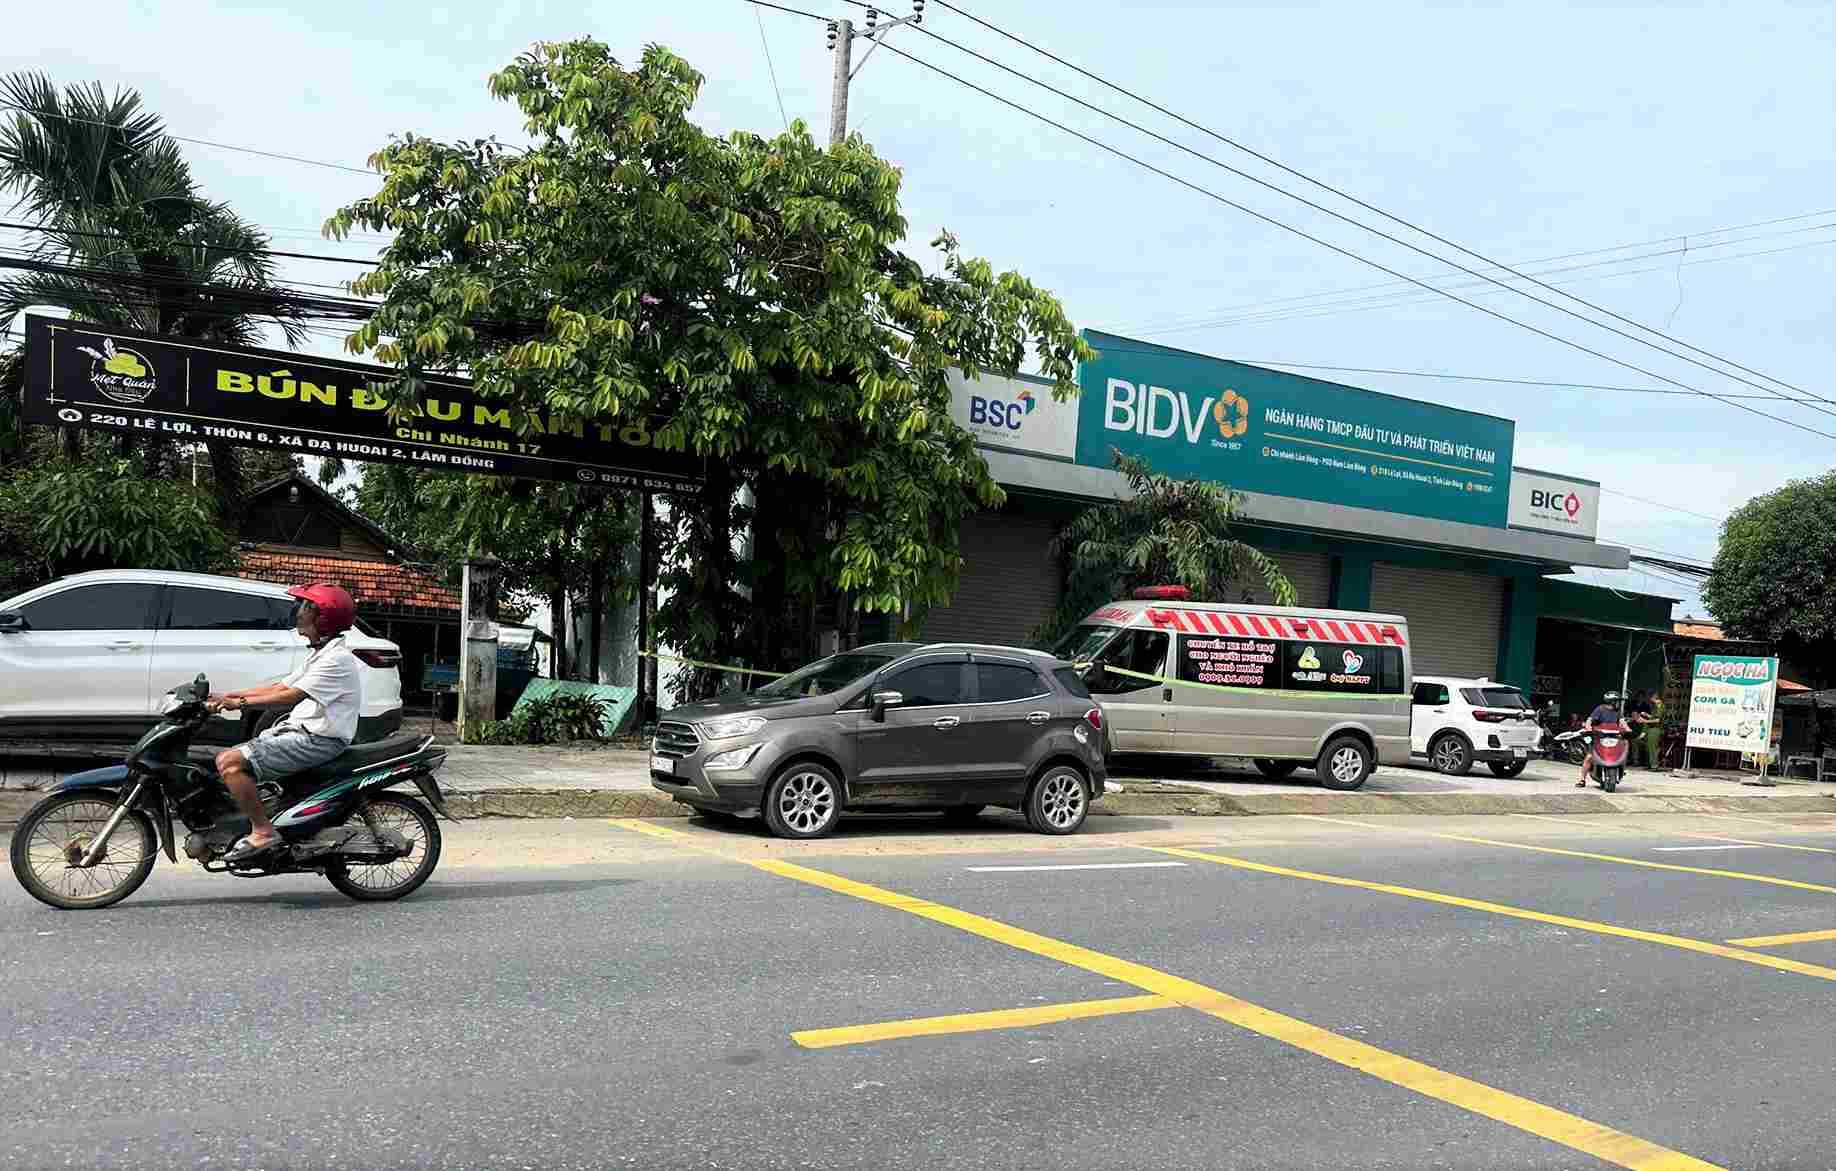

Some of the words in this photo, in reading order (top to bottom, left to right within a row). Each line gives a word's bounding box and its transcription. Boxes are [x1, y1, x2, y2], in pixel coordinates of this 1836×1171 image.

[216, 369, 337, 406] BÚN
[348, 384, 462, 422] ĐU
[970, 395, 1022, 430] BSC
[1104, 378, 1215, 444] BIDV
[90, 412, 128, 427] 220
[134, 417, 157, 430] LÊ
[203, 424, 252, 441] THÔN
[279, 434, 303, 447] XÃ
[307, 438, 332, 451] ĐẠ
[336, 442, 387, 456] HUOAI
[411, 449, 447, 464] LÂM
[451, 453, 495, 468] ĐỒNG
[395, 427, 433, 442] Chi
[440, 431, 510, 451] Nhánh
[516, 442, 543, 455] 17
[1264, 407, 1294, 426] NGÂN
[1295, 411, 1325, 431] HÀNG
[1326, 419, 1353, 438] TMCP
[1354, 423, 1375, 441] ĐẦU
[1376, 428, 1390, 443] TƯ
[1390, 429, 1402, 447] VÀ
[1403, 432, 1428, 450] PHÁT
[1428, 438, 1455, 457] TRIỂN
[1455, 443, 1476, 461] VIỆT
[1475, 447, 1496, 465] NAM
